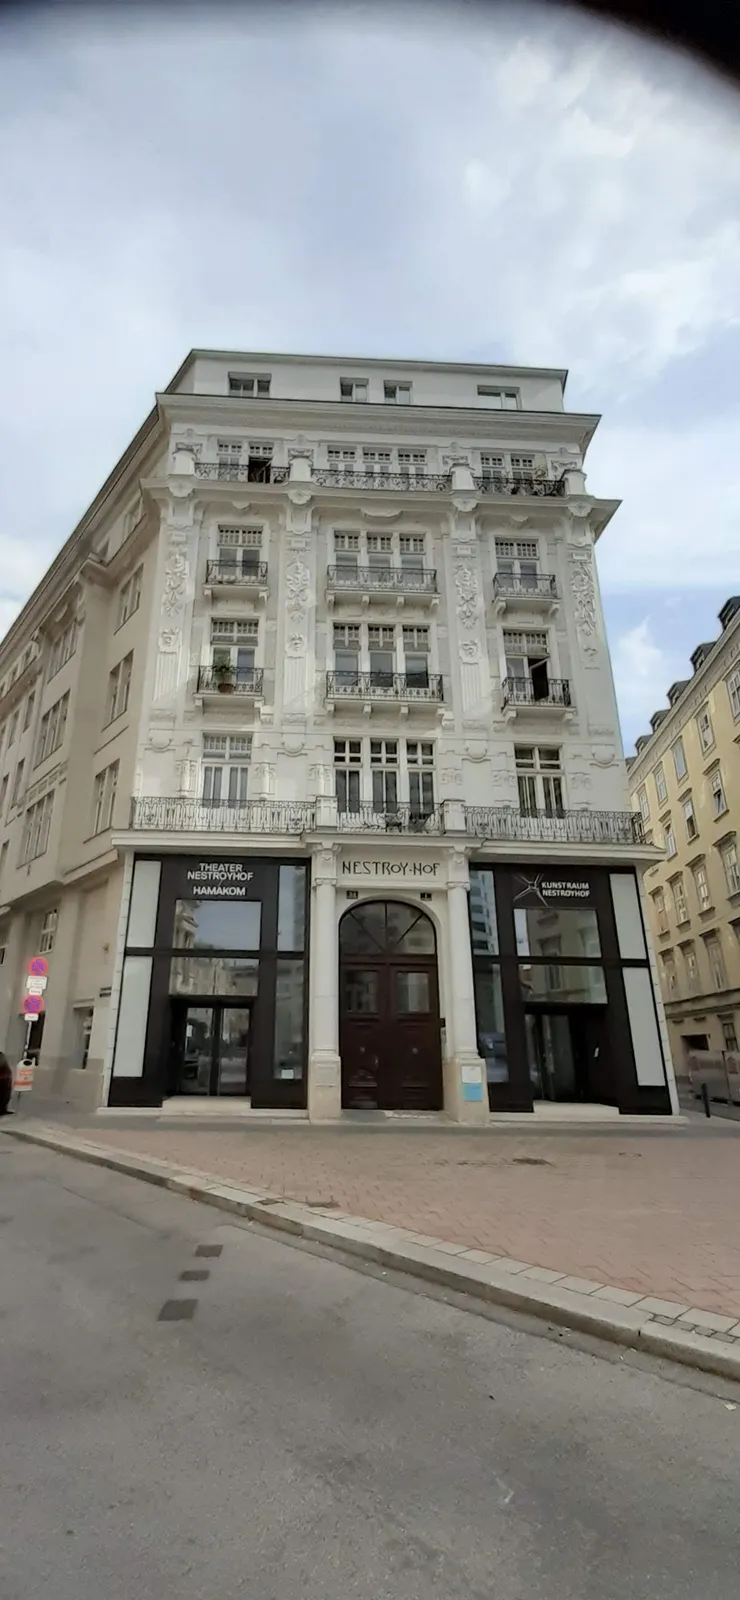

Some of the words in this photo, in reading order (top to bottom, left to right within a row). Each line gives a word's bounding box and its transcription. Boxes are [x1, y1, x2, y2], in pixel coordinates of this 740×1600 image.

[199, 862, 243, 872] THEATER
[342, 861, 440, 876] NESTROY-HOF
[187, 871, 254, 881] NESTROYHOF
[541, 881, 589, 890] KUNSTRAUM
[193, 886, 246, 896] HAMAKOM
[542, 889, 590, 898] NESTROYHOF
